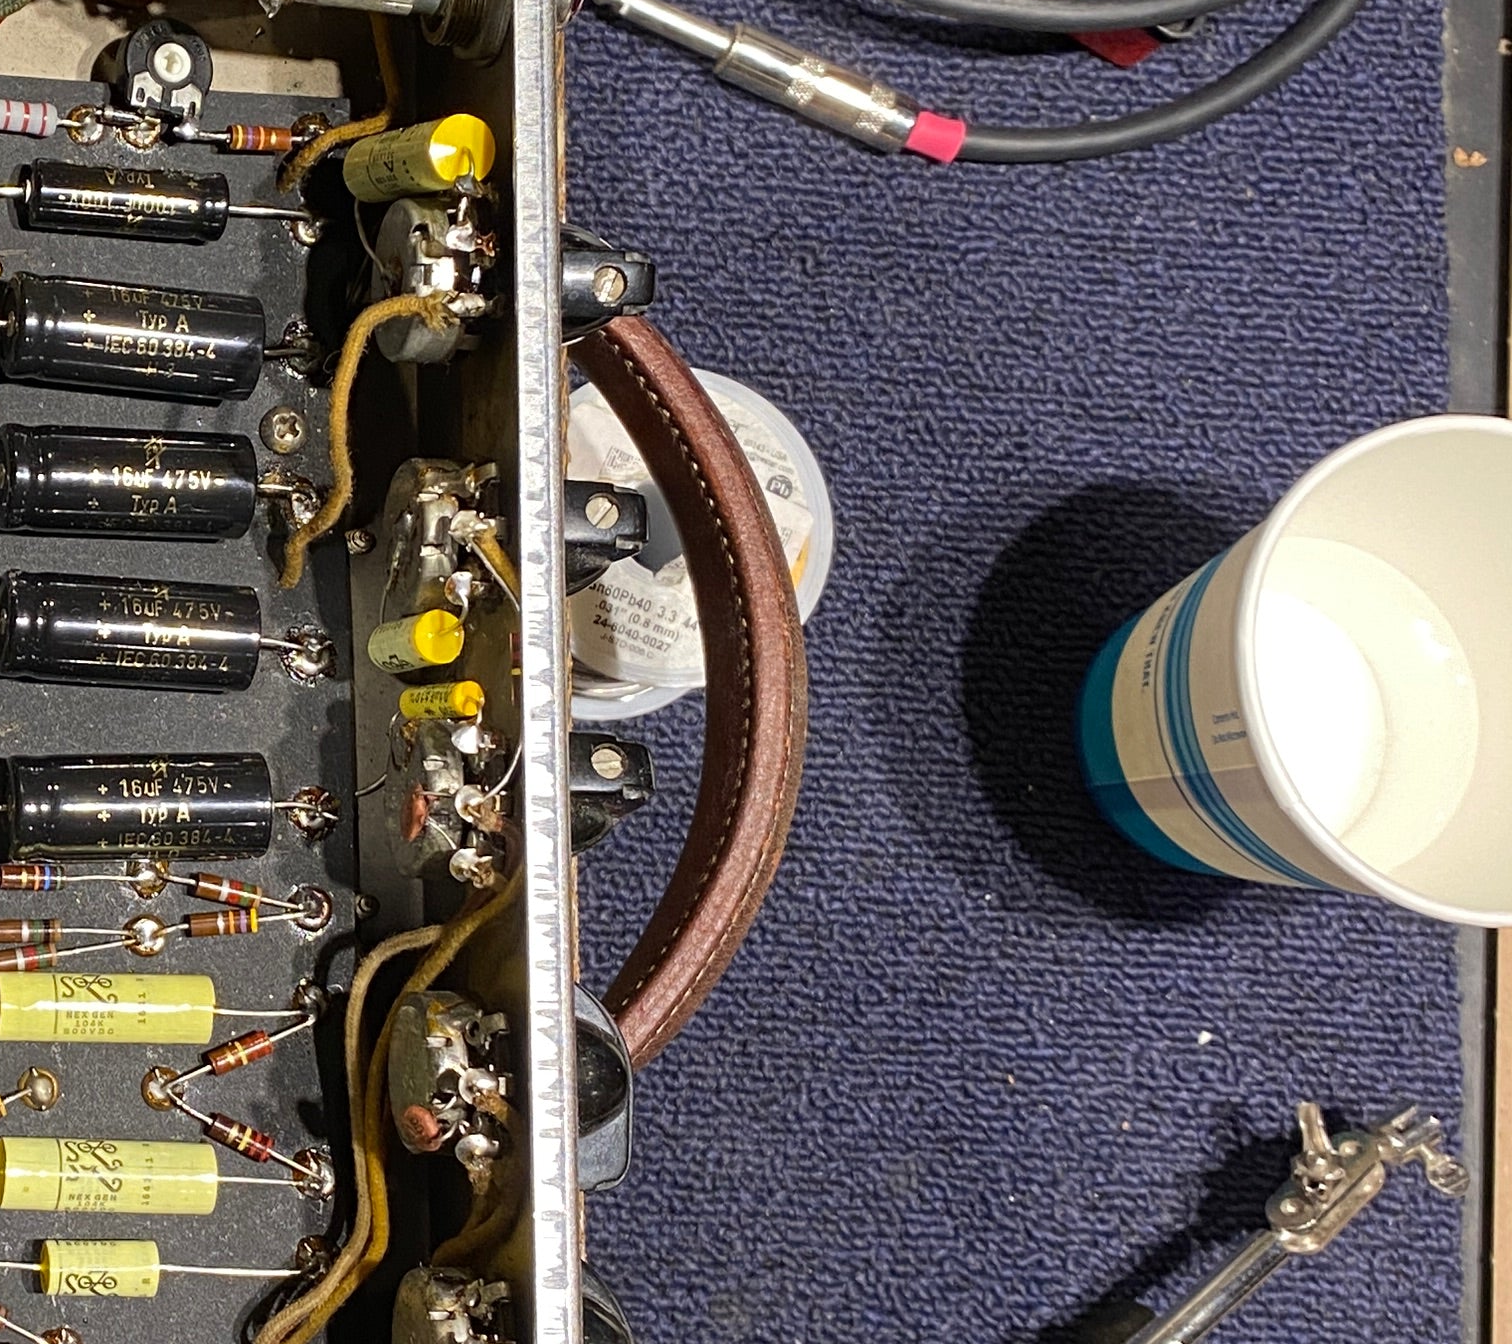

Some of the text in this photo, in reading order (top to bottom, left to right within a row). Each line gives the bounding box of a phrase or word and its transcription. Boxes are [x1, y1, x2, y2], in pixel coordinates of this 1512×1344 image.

[138, 309, 190, 334] Typ A
[103, 334, 134, 356] IEC
[161, 469, 212, 490] 475V
[129, 494, 178, 517] Typ A
[172, 602, 222, 622] 475V
[656, 605, 678, 624] 3.3
[176, 625, 192, 647] A
[592, 613, 672, 654] 24-6040-0027
[627, 609, 652, 628] (0.8
[652, 619, 680, 643] mm)
[114, 649, 145, 668] IEC
[175, 653, 231, 673] 384-4
[171, 775, 220, 796] 475V
[175, 801, 192, 824] A
[117, 831, 148, 849] IEC
[178, 827, 237, 846] 384-4
[65, 1010, 115, 1020] NEX GEN
[68, 1193, 118, 1202] NEX GEN
